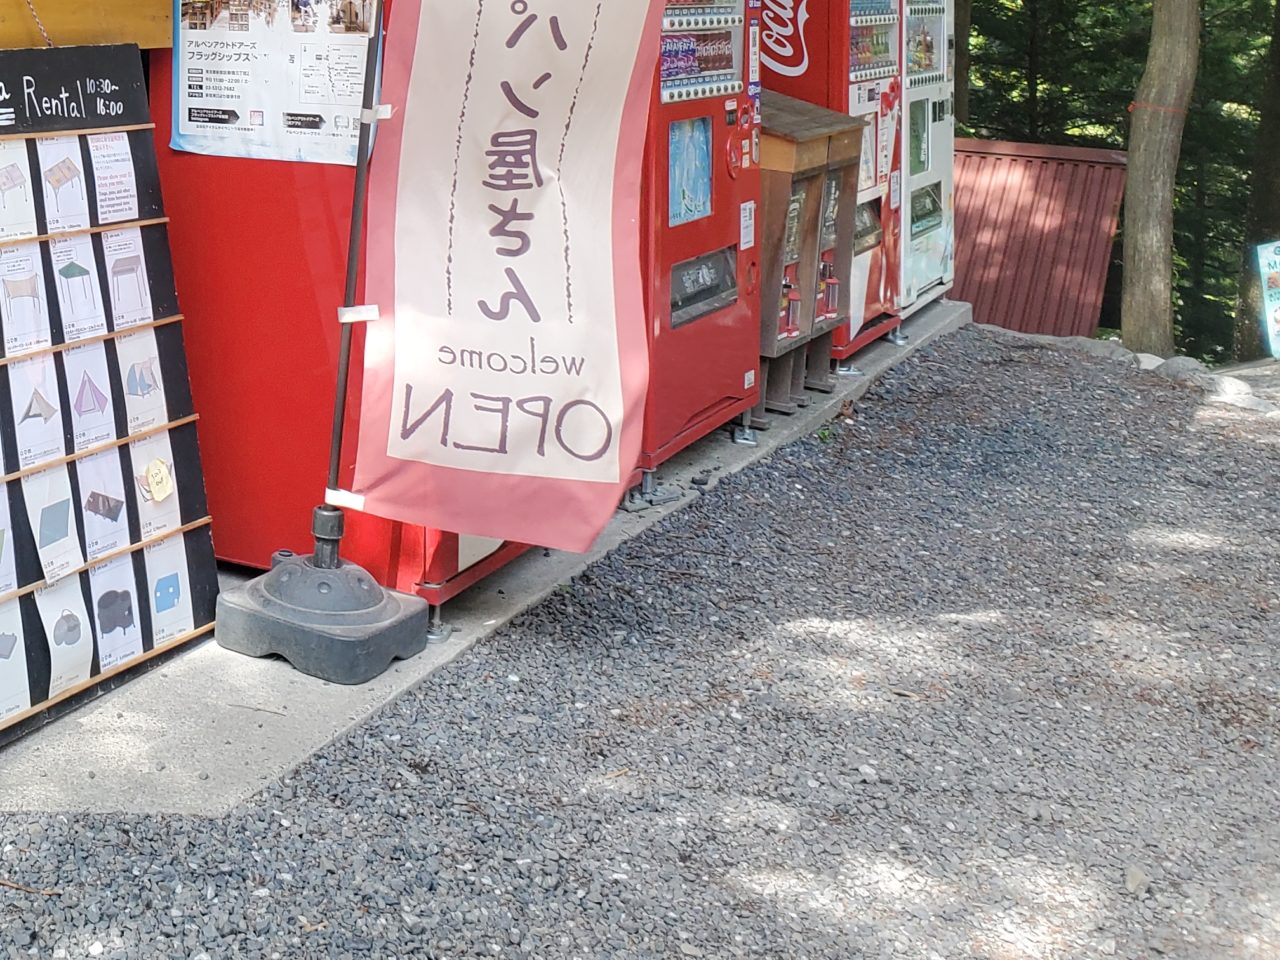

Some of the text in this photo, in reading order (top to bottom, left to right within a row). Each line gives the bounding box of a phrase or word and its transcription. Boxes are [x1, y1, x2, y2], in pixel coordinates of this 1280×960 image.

[187, 40, 257, 49] アルペンアウトドアーズ
[23, 76, 86, 118] Rental
[96, 97, 123, 116] 16:00
